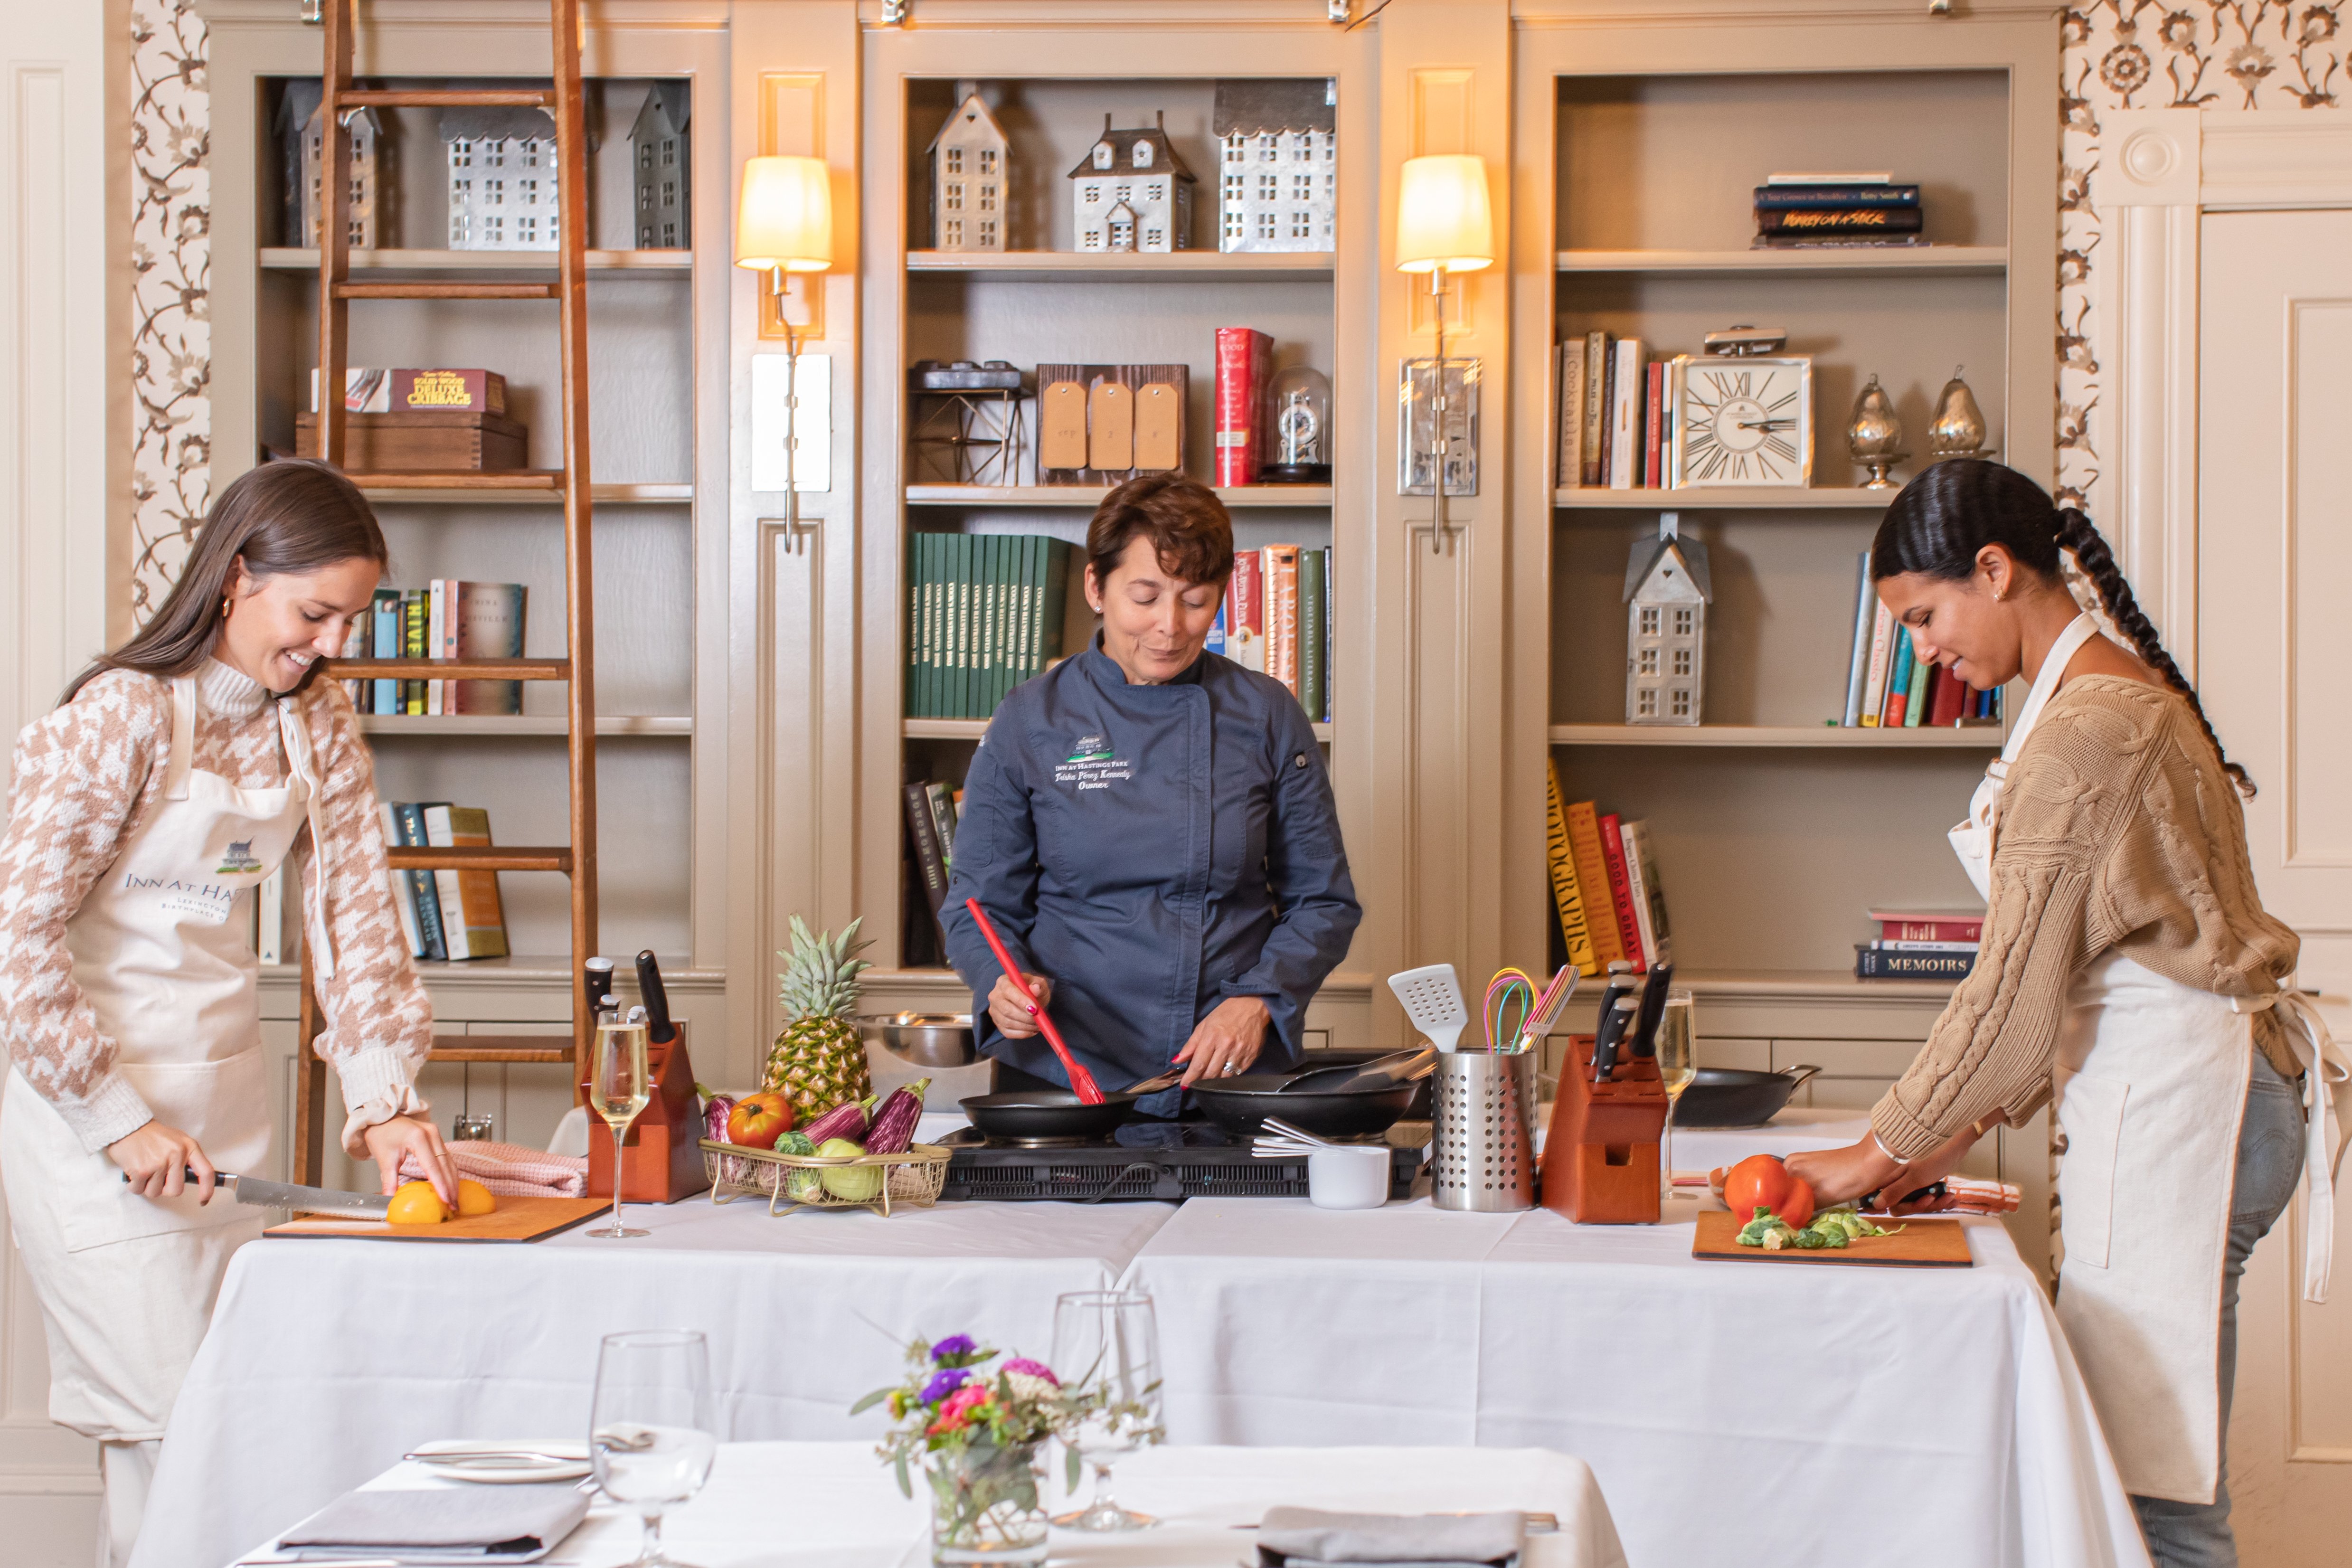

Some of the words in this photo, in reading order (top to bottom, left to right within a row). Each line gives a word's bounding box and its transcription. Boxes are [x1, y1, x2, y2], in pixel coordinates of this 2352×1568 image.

[1819, 213, 1841, 226] ON
[1851, 212, 1885, 225] STICK
[407, 393, 472, 405] CRIBBAGE
[414, 384, 464, 395] DELUXE
[407, 605, 422, 653] HIVE
[946, 608, 954, 650] ILLUSTRATED
[959, 610, 967, 651] ILLUSTRATED
[984, 610, 992, 652] ILLUSTRATED
[1008, 611, 1016, 652] ILLUSTRATED
[1877, 602, 1886, 636] erican
[1020, 612, 1029, 653] ILLUSTRATED
[1871, 638, 1884, 682] Classics
[1055, 773, 1076, 782] Trisha
[1100, 769, 1131, 780] Kennedy
[1078, 781, 1110, 790] Owner
[125, 873, 164, 889] INN
[167, 880, 196, 891] AT
[162, 903, 214, 918] BIRTHPLACE
[178, 897, 227, 914] LEXINGTON
[1610, 854, 1623, 886] GOOD
[1617, 892, 1627, 908] TO
[1622, 915, 1637, 956] GREAT
[1888, 958, 1967, 972] MEMOIRS
